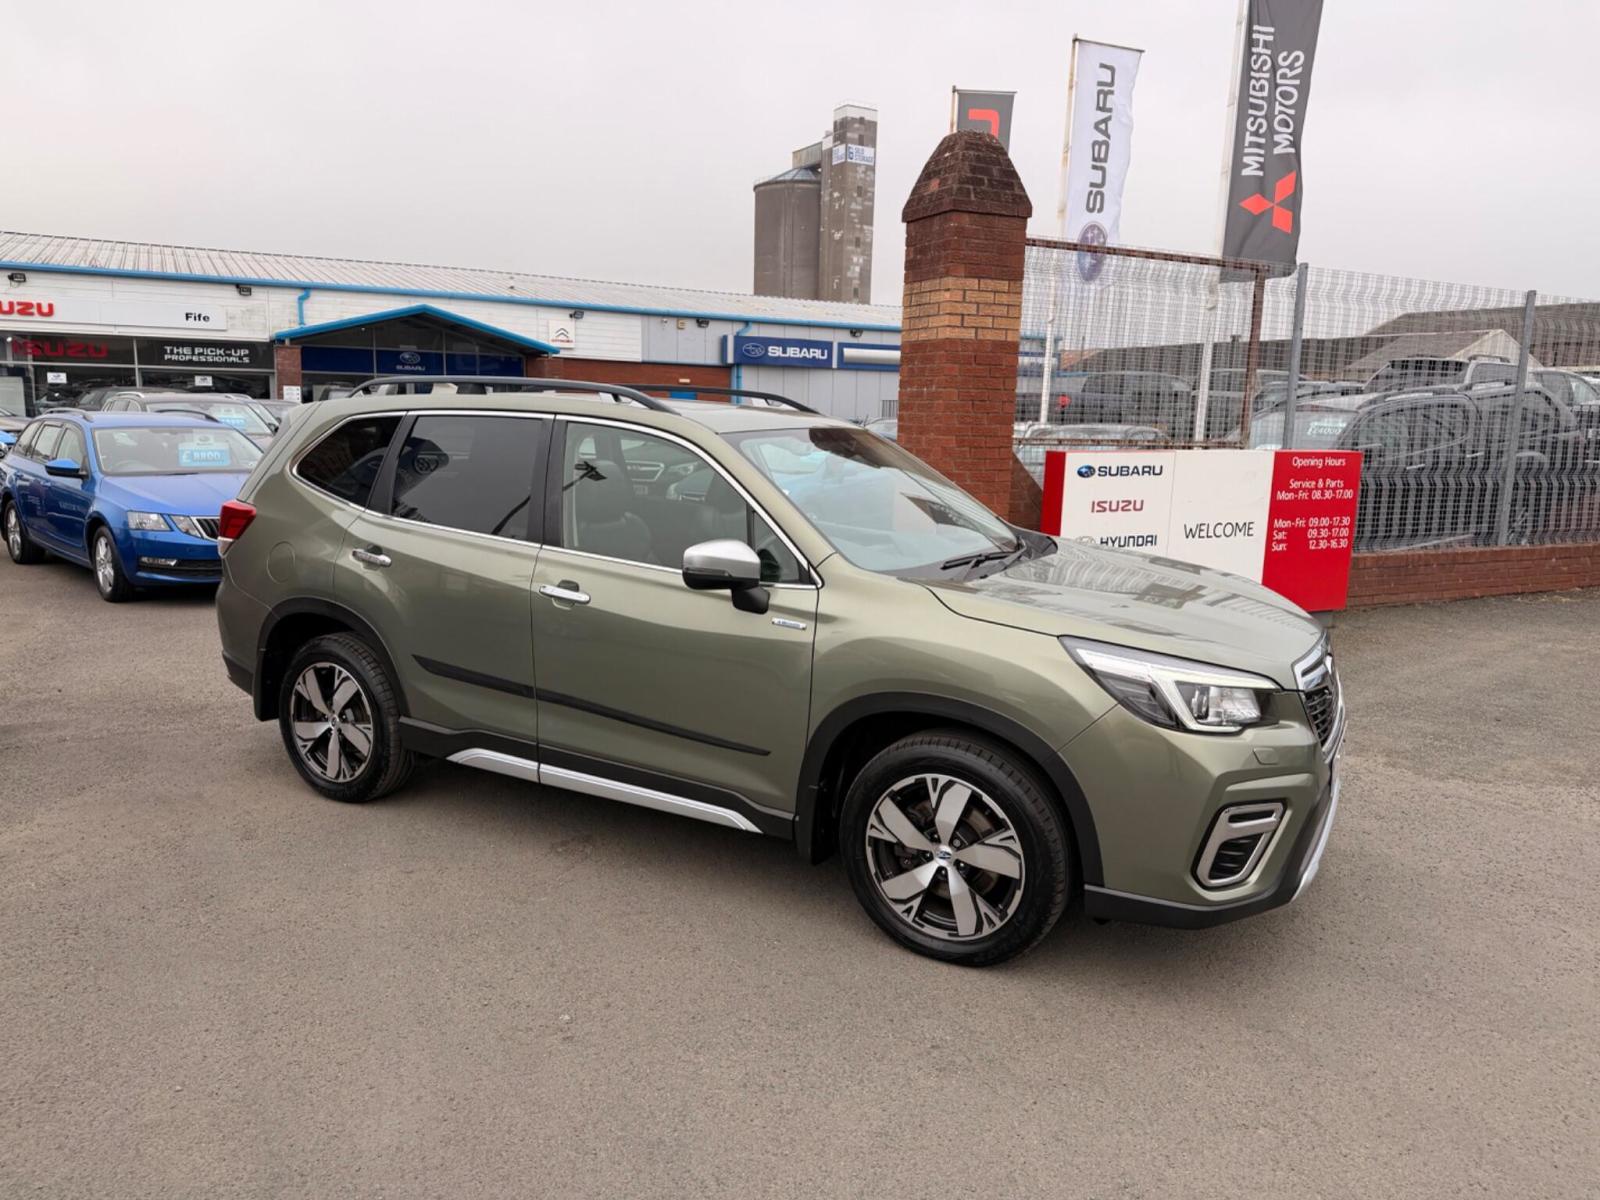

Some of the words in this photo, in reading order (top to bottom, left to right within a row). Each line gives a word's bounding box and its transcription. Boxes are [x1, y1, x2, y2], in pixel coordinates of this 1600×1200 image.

[1241, 24, 1275, 176] MITSUBISHI
[1273, 50, 1305, 155] MOTORS
[1085, 63, 1116, 214] SUBARU
[185, 312, 210, 322] Fife
[164, 346, 192, 355] THE
[194, 347, 249, 357] PICK-UP
[767, 345, 828, 360] SUBARU
[164, 354, 250, 363] PROFESSIONALS
[1292, 456, 1323, 469] Opening
[1324, 456, 1346, 467] Hours
[1097, 465, 1163, 477] SUBARU
[1289, 478, 1316, 489] Service
[1317, 478, 1324, 488] &
[1325, 478, 1344, 488] Parts
[1311, 489, 1354, 500] 08.30-17.00
[1091, 499, 1144, 513] ISUZU
[1183, 521, 1255, 539] WELCOME
[1307, 527, 1349, 539] 09.30-17.00
[1100, 534, 1157, 547] HYUNDAI
[1309, 538, 1349, 550] 12.30-16.30
